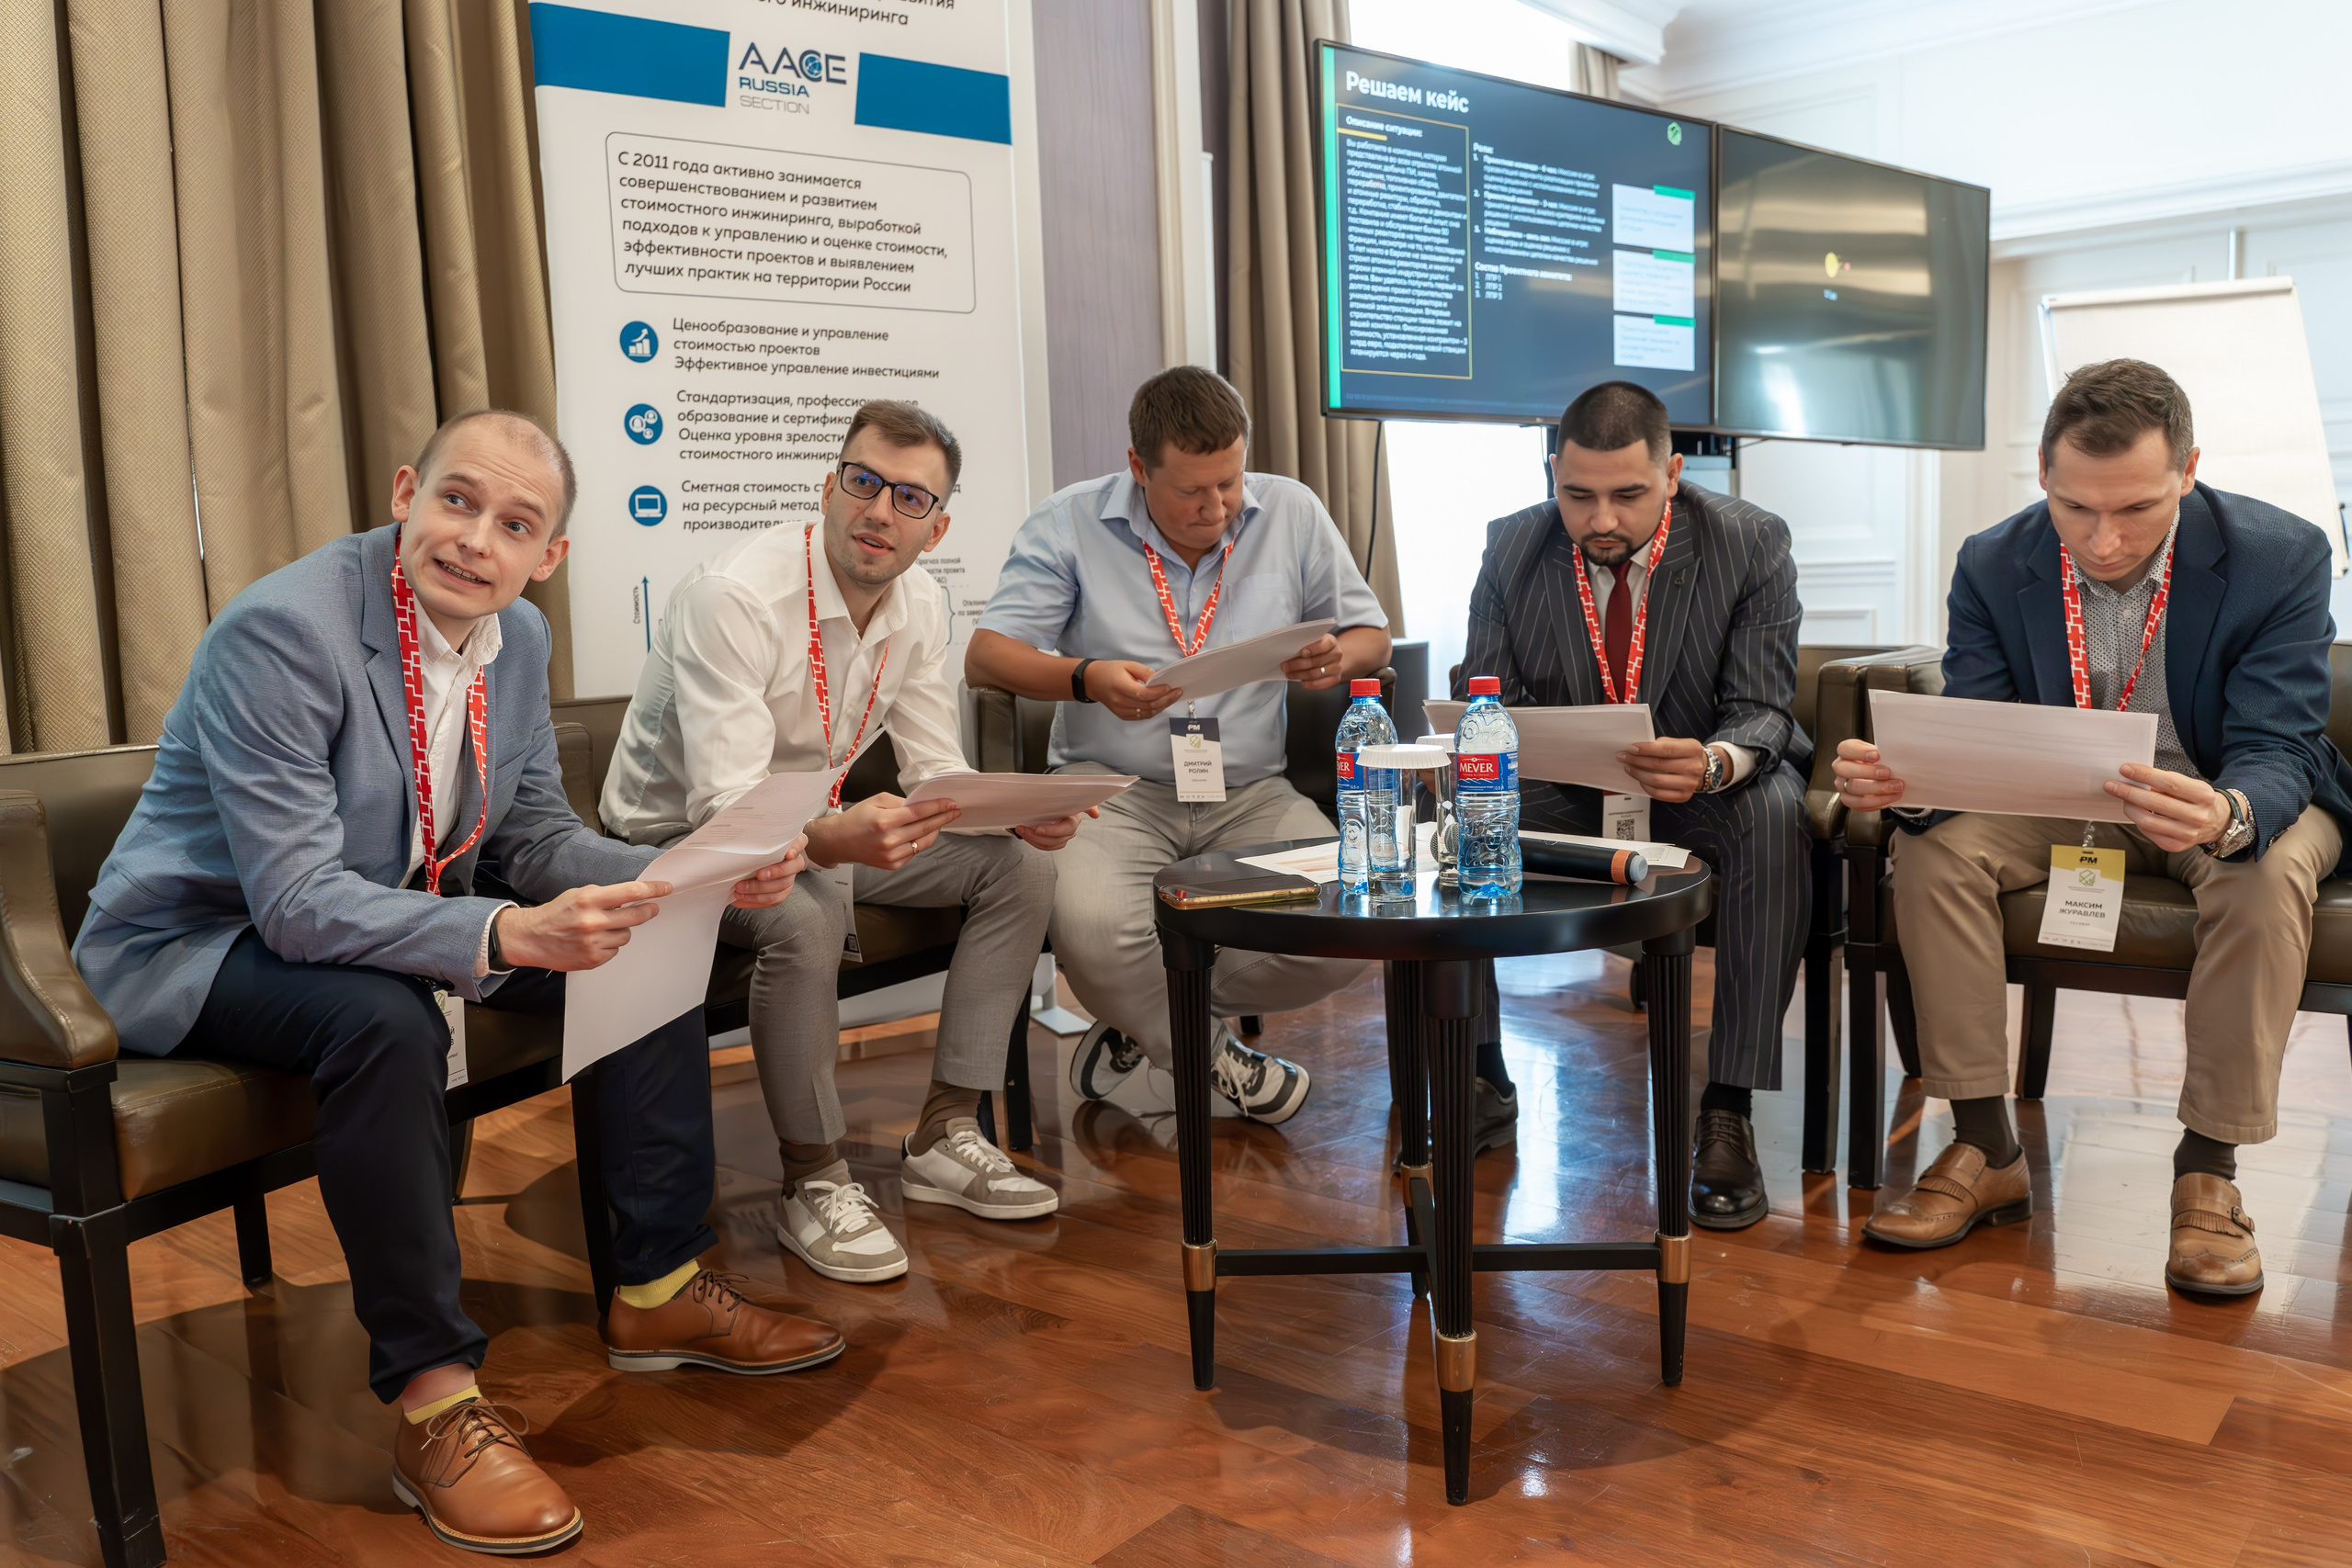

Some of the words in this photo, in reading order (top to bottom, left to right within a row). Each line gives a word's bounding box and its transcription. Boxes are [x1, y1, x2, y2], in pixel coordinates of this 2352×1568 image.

[791, 0, 909, 26] инжиниринга
[738, 41, 847, 85] AACE
[739, 76, 809, 97] RUSSIA
[1346, 70, 1422, 105] Решаем
[1426, 89, 1469, 113] кейс
[740, 95, 809, 115] SECTION
[617, 151, 629, 165] С
[633, 152, 669, 169] 2011
[673, 160, 709, 174] года
[713, 164, 775, 181] активно
[778, 171, 862, 189] занимается
[619, 176, 786, 202] совершенствованием
[790, 194, 798, 203] и
[802, 194, 877, 210] развитием
[621, 197, 728, 218] стоимостного
[732, 209, 833, 230] инжиниринга,
[838, 218, 921, 235] выработкой
[623, 220, 698, 235] подходов
[702, 227, 710, 236] к
[715, 227, 807, 244] управлению
[811, 236, 820, 245] и
[823, 238, 872, 251] оценке
[876, 241, 947, 259] стоимости,
[624, 239, 742, 259] эффективности
[747, 251, 814, 265] проектов
[819, 256, 826, 266] и
[831, 257, 914, 273] выявлением
[625, 263, 684, 277] лучших
[688, 267, 750, 282] практик
[753, 273, 772, 283] на
[776, 275, 859, 290] территории
[864, 276, 911, 292] России
[673, 318, 798, 337] Ценообразование
[801, 327, 809, 337] и
[812, 327, 888, 341] управление
[673, 340, 755, 354] стоимостью
[759, 344, 820, 356] проектов
[674, 356, 768, 372] Эффективное
[771, 362, 849, 376] управление
[853, 367, 939, 378] инвестициями
[676, 389, 793, 407] Стандартизация,
[678, 411, 768, 424] образование
[772, 415, 779, 423] и
[783, 413, 852, 427] сертифика
[679, 428, 731, 442] Оценка
[735, 432, 782, 445] уровня
[786, 432, 844, 445] зрелости
[680, 449, 773, 460] стоимостного
[776, 450, 841, 463] инжинири
[682, 480, 740, 492] Сметная
[743, 482, 810, 493] стоимость
[683, 501, 700, 512] на
[703, 499, 777, 513] ресурсный
[781, 501, 820, 512] метод
[1460, 762, 1494, 773] MEVER
[2058, 908, 2106, 919] ЖУРАВЛЕВ
[2065, 900, 2102, 909] МАКСИМ
